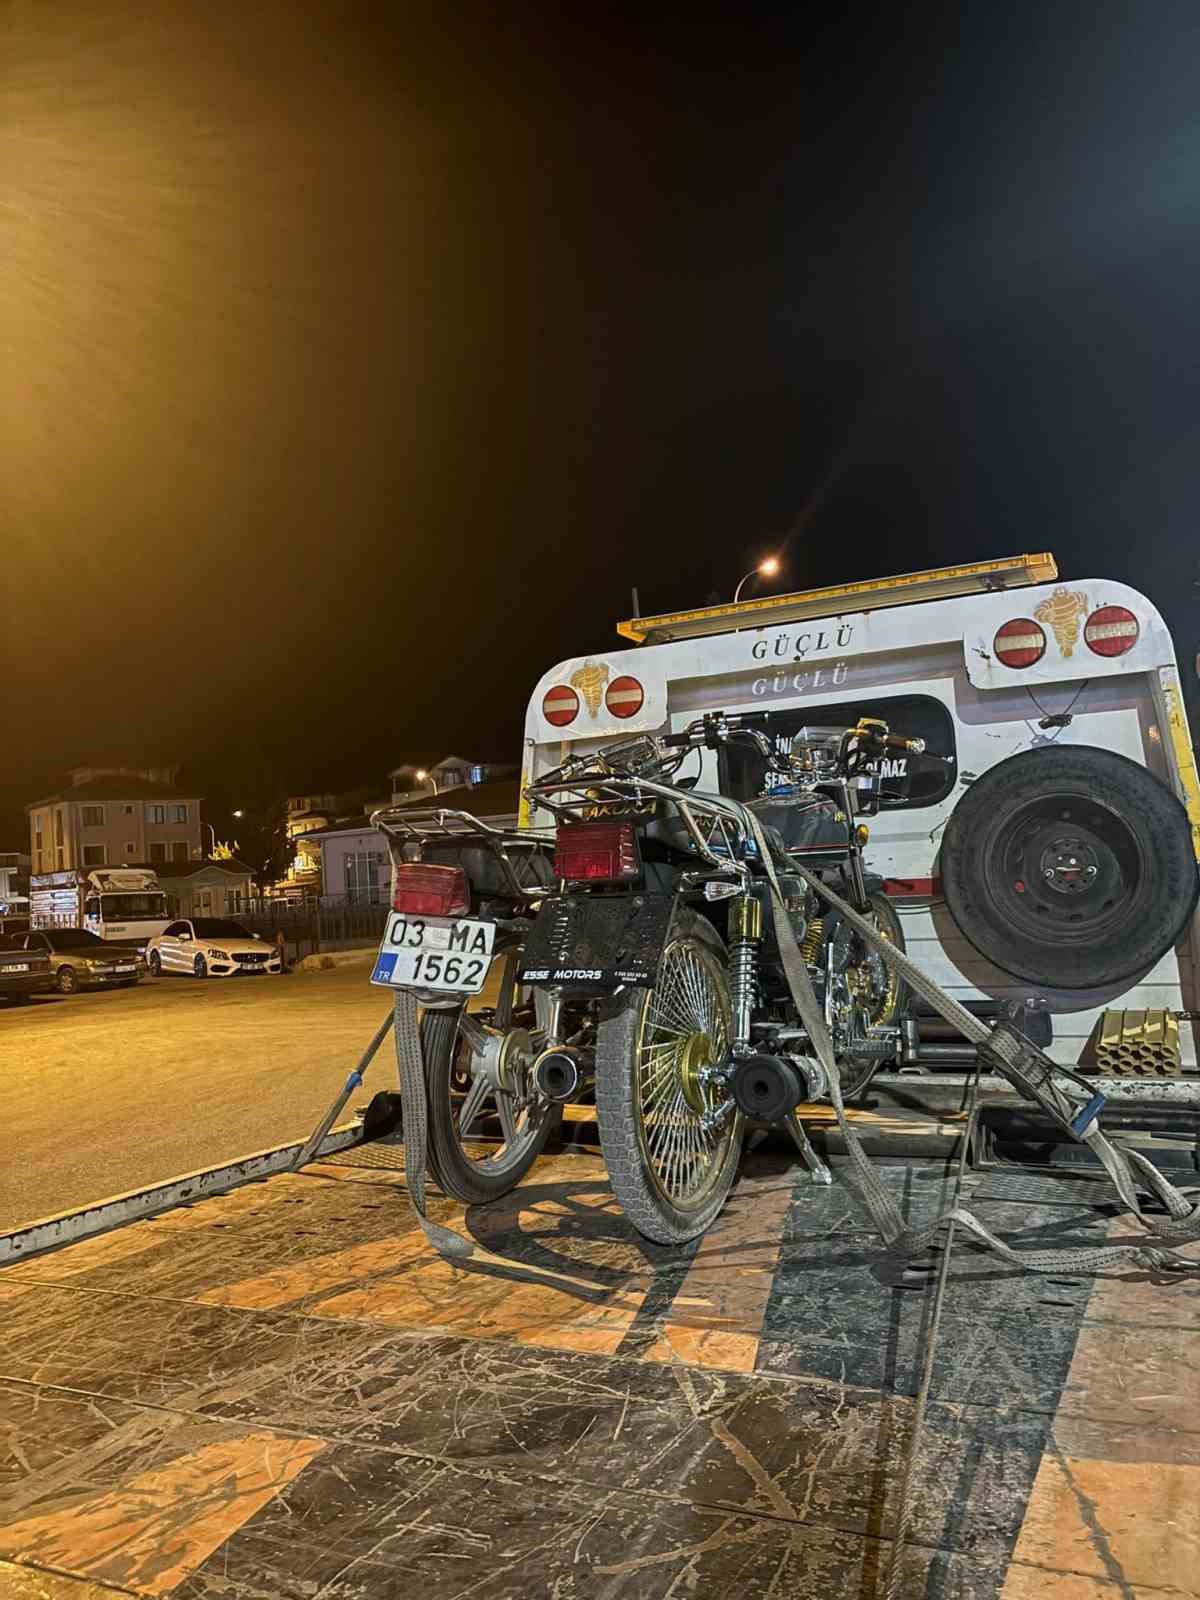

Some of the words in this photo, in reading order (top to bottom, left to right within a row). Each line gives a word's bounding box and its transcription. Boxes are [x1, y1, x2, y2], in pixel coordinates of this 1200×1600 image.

[752, 624, 853, 659] GÜÇLÜ
[752, 662, 848, 695] GÜÇLÜ
[390, 919, 425, 948] 03
[448, 923, 487, 954] MA
[378, 970, 391, 981] TR
[413, 953, 484, 986] 1562
[522, 970, 550, 980] ESSE
[553, 969, 602, 980] MOTORS
